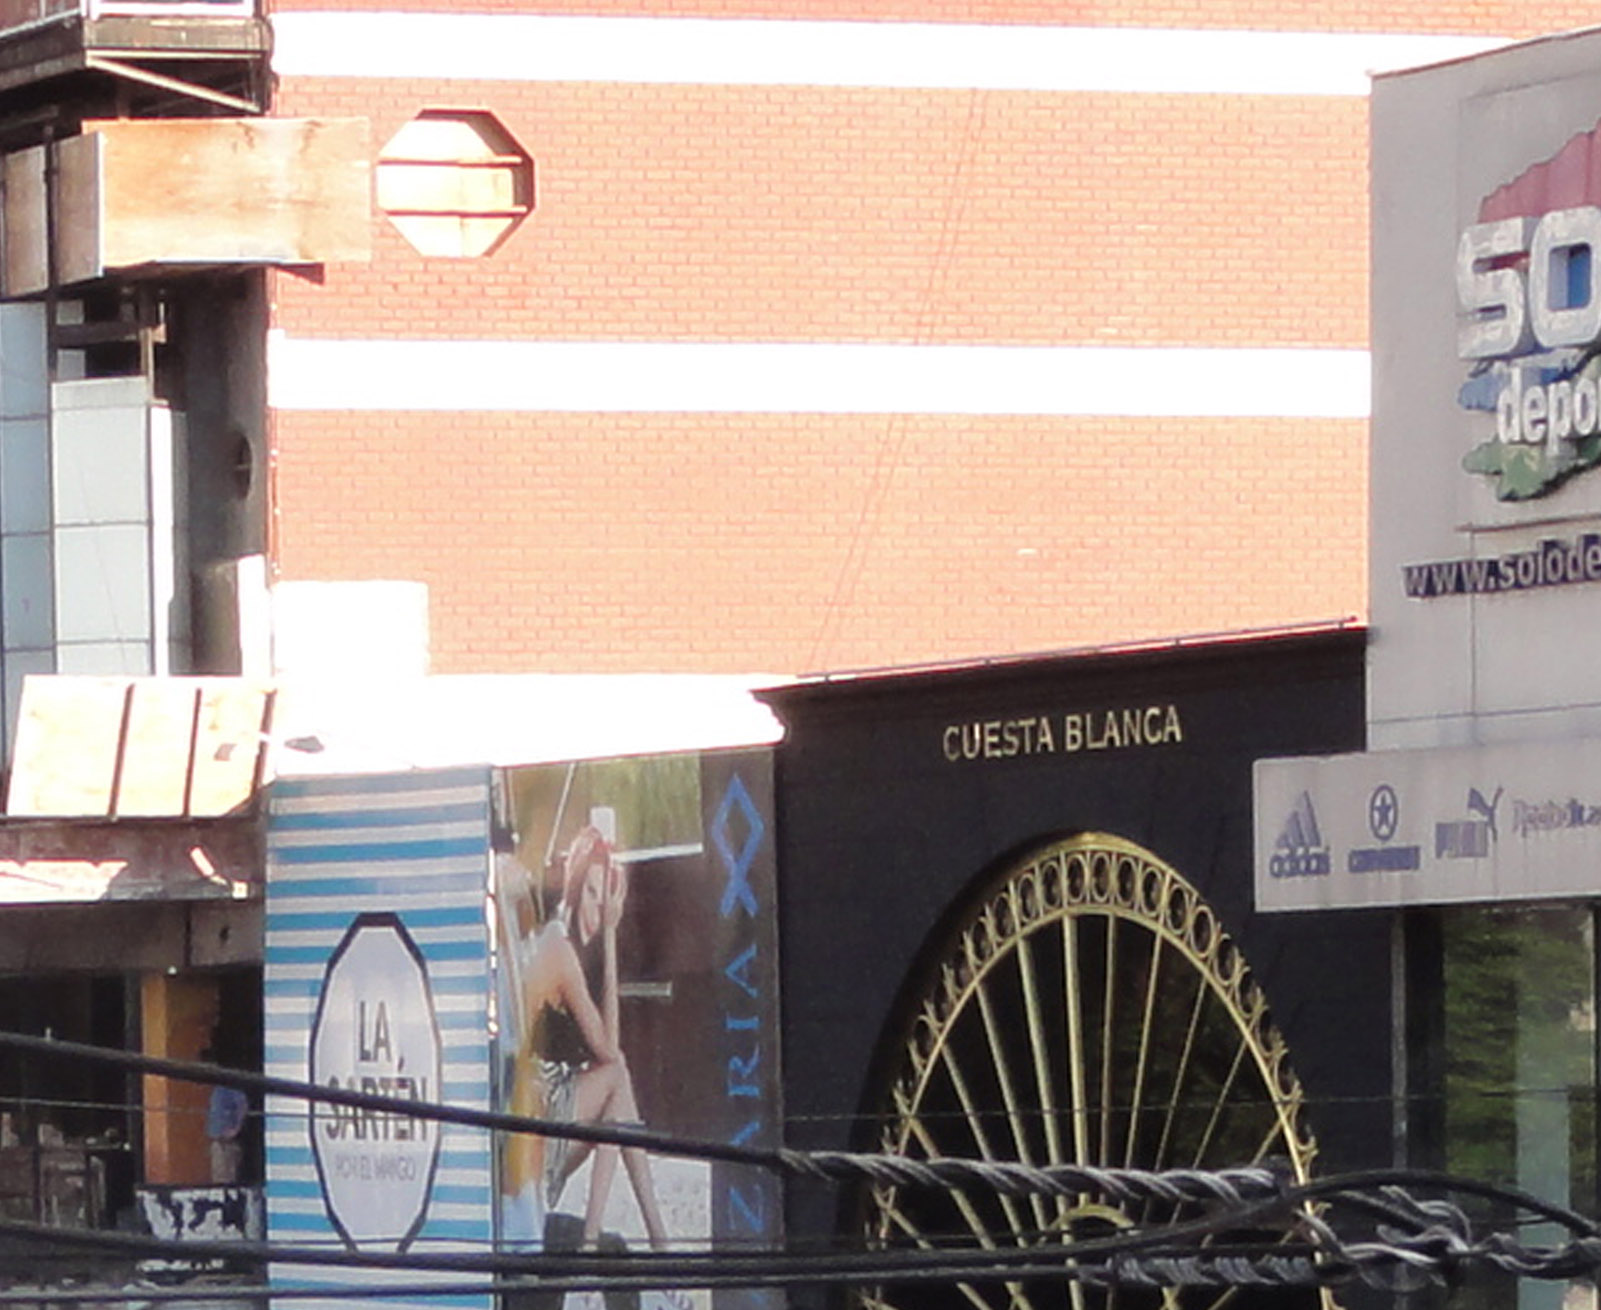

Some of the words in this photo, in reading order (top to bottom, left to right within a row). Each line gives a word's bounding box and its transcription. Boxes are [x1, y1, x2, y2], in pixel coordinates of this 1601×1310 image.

[943, 716, 1054, 762] CUESTA
[1065, 705, 1182, 752] BLANCA
[359, 1000, 392, 1063] LA
